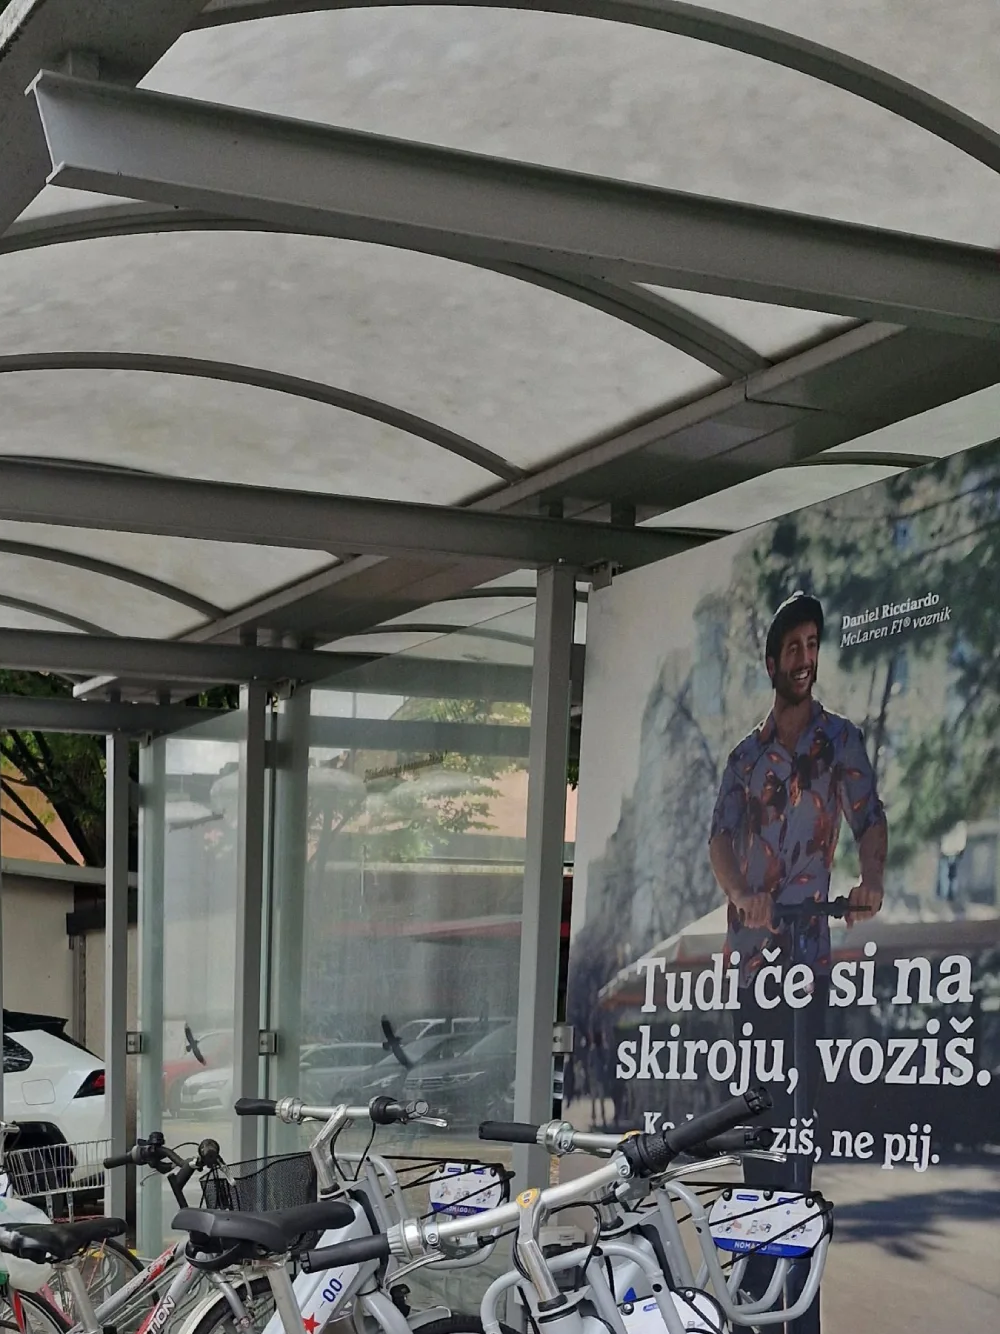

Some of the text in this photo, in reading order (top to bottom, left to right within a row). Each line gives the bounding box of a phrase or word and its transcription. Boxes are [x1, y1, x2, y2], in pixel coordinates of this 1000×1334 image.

[840, 629, 888, 648] McLaren
[913, 606, 952, 629] voznik
[842, 592, 940, 630] Daniel Ricciardo
[637, 942, 974, 1013] Tudi če si na
[616, 1016, 992, 1097] skiroju, voziš.
[830, 1129, 874, 1158] ne
[881, 1124, 940, 1173] pij.
